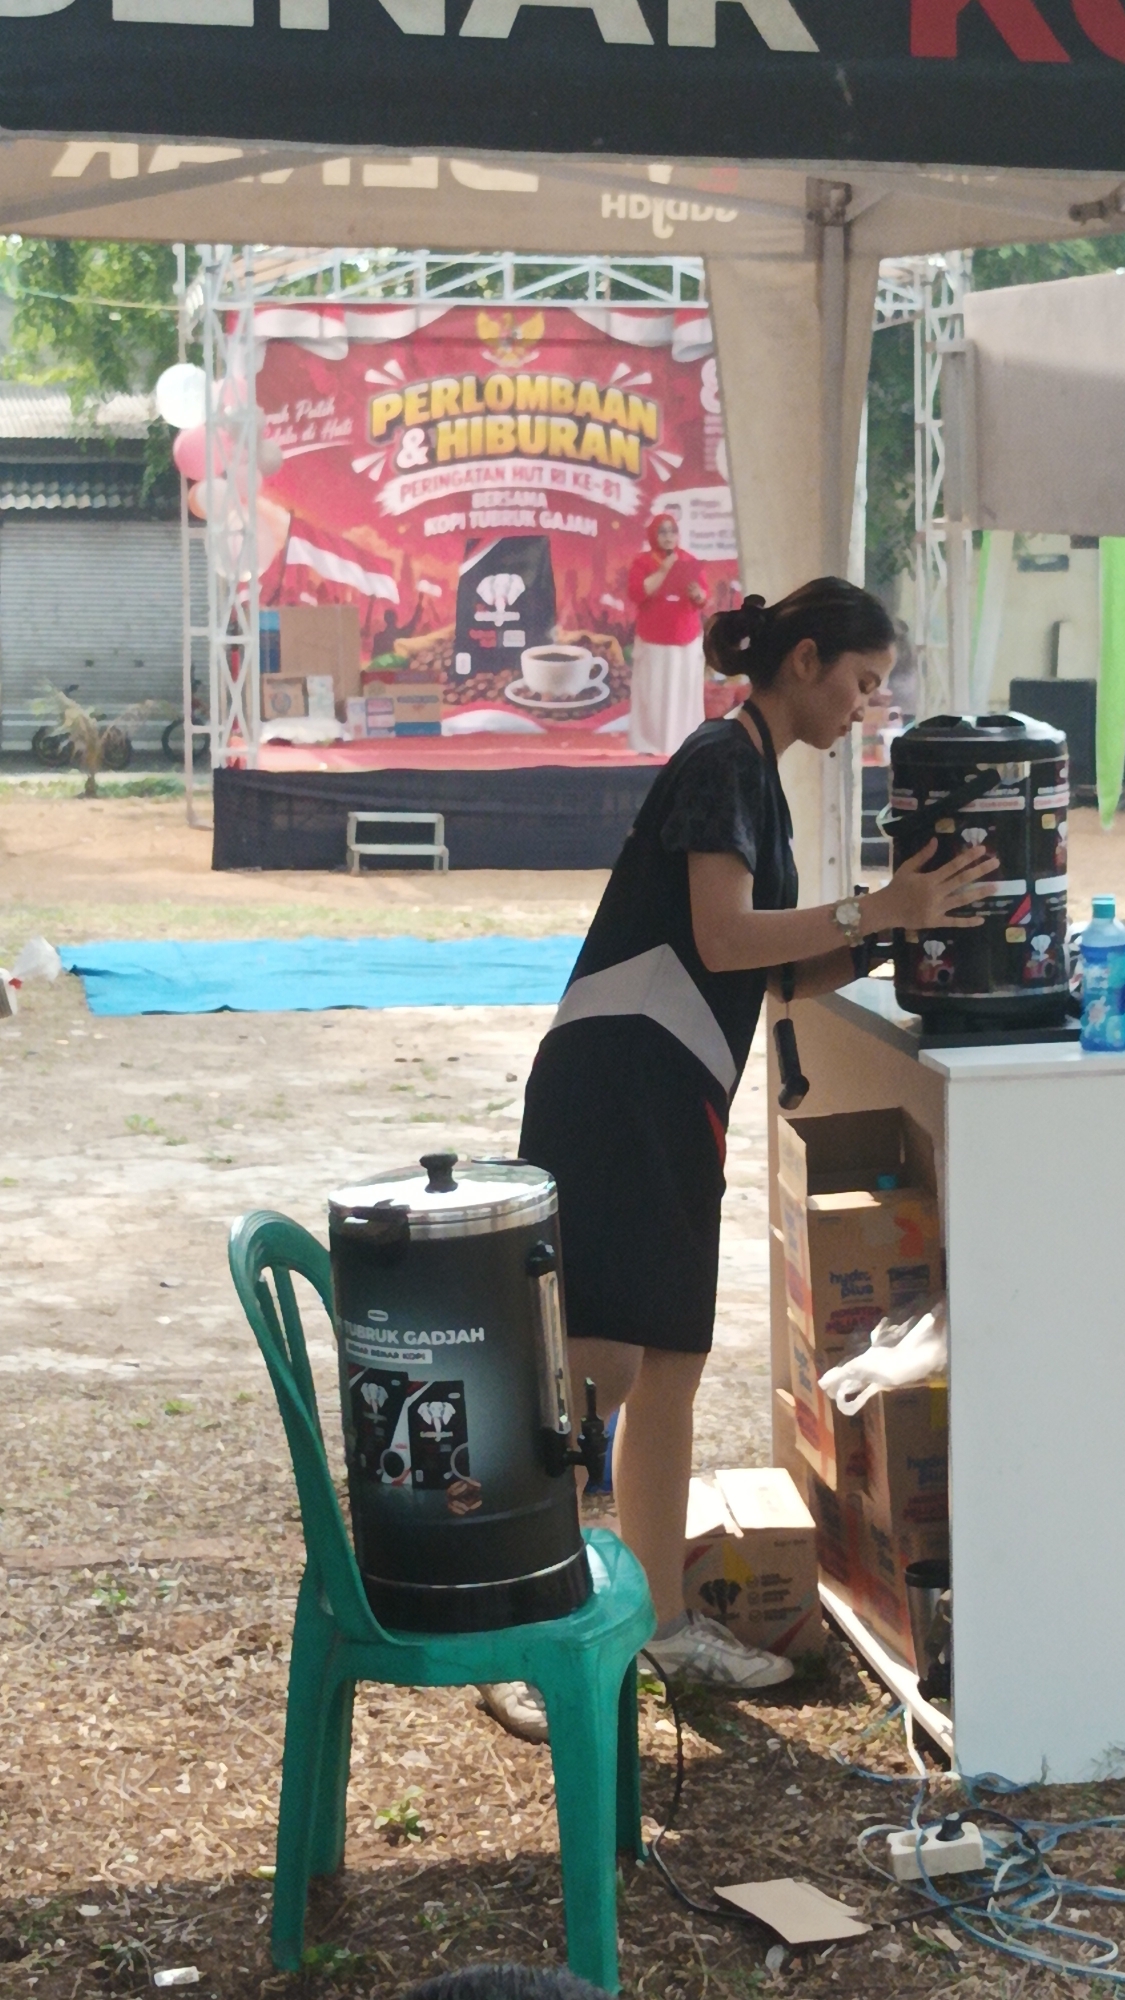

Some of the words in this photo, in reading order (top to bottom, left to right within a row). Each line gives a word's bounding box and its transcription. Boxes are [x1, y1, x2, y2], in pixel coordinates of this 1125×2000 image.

[372, 373, 657, 441] PERLOMBAAN
[396, 427, 429, 469] &
[436, 414, 640, 475] HIBURAN
[399, 466, 506, 502] PERINGATAN
[512, 466, 544, 484] HUT
[472, 490, 549, 509] BERSAMA
[424, 512, 466, 537] KOPI
[469, 510, 537, 529] TUBRUK
[539, 510, 598, 537] GAJAH
[343, 1319, 400, 1345] TUBRUK
[403, 1327, 486, 1346] GADJAH
